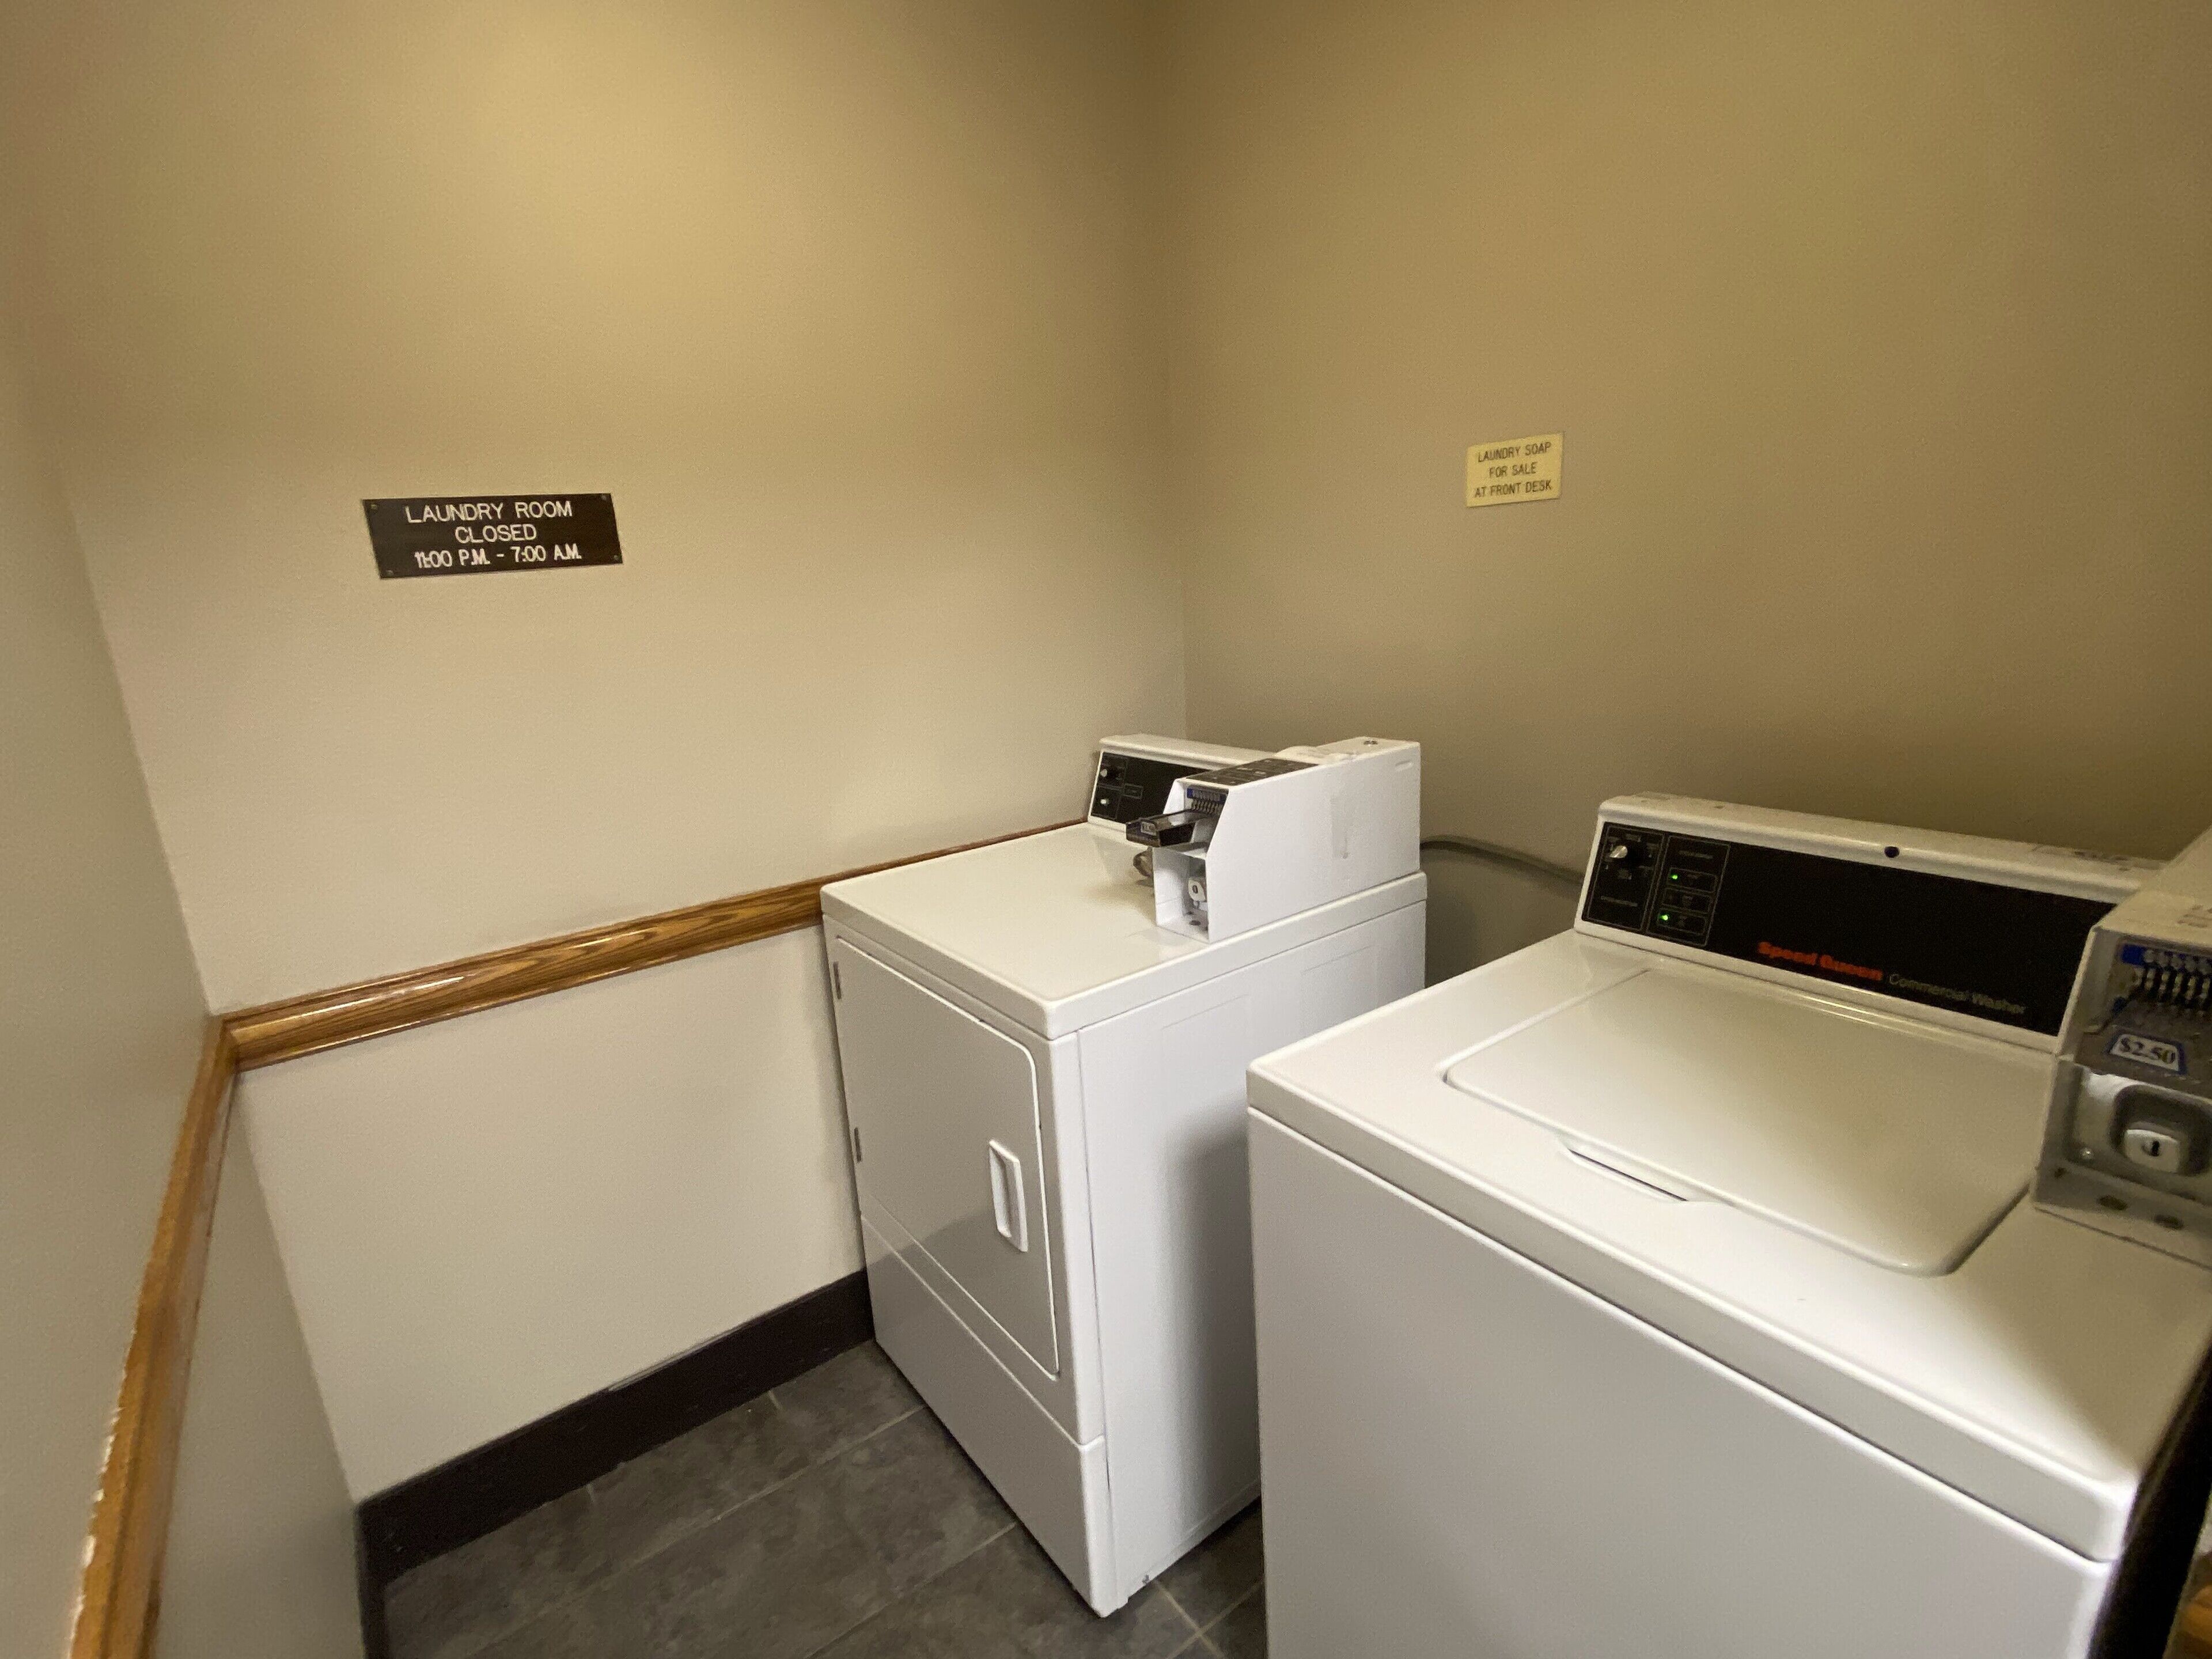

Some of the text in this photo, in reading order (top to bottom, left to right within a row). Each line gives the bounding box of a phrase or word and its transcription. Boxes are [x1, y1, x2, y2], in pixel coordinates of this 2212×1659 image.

[1478, 441, 1551, 463] LAUNDRY SOAP
[1489, 461, 1537, 478] FOR SALE
[1474, 479, 1552, 498] AT FRONT DESK
[405, 501, 573, 523] LAUNDRY ROOM
[454, 523, 537, 543] CLOSED
[414, 550, 453, 569] 11:00
[511, 547, 547, 563] 7:00
